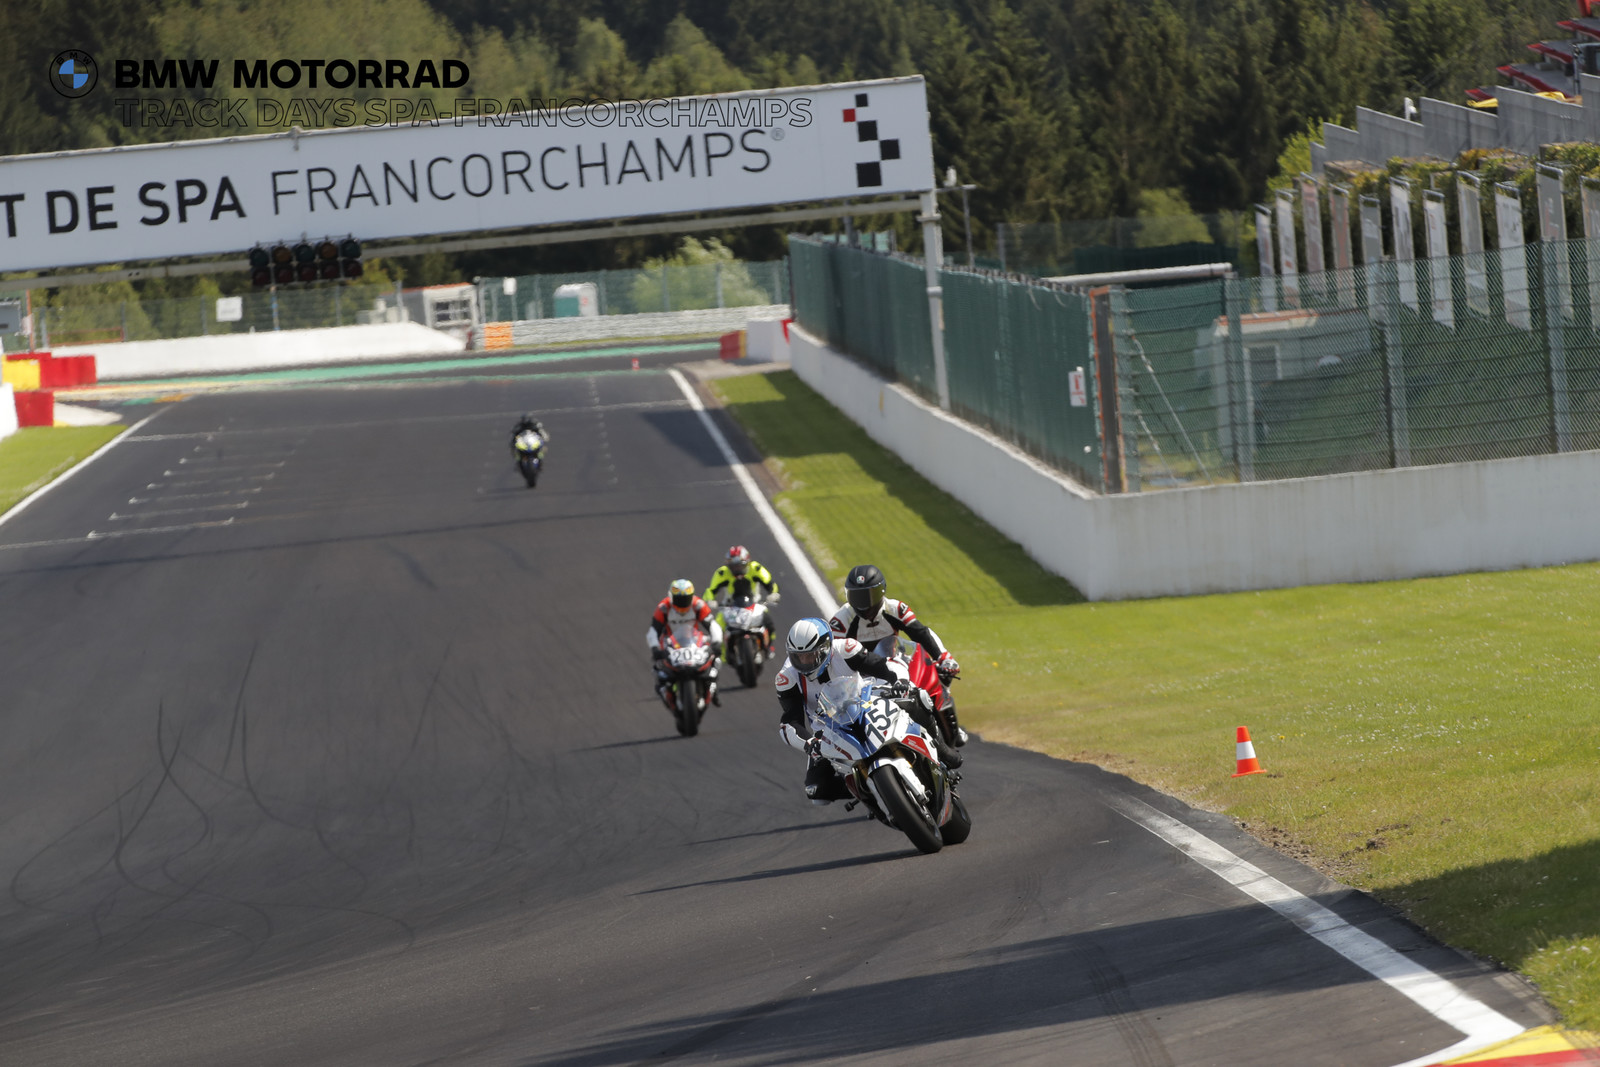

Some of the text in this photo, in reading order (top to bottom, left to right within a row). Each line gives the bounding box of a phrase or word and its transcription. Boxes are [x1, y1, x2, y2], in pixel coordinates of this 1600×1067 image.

[46, 186, 118, 234] DE
[139, 176, 247, 225] SPA
[271, 128, 771, 215] FRANCORCHAMPS
[866, 697, 899, 744] 152
